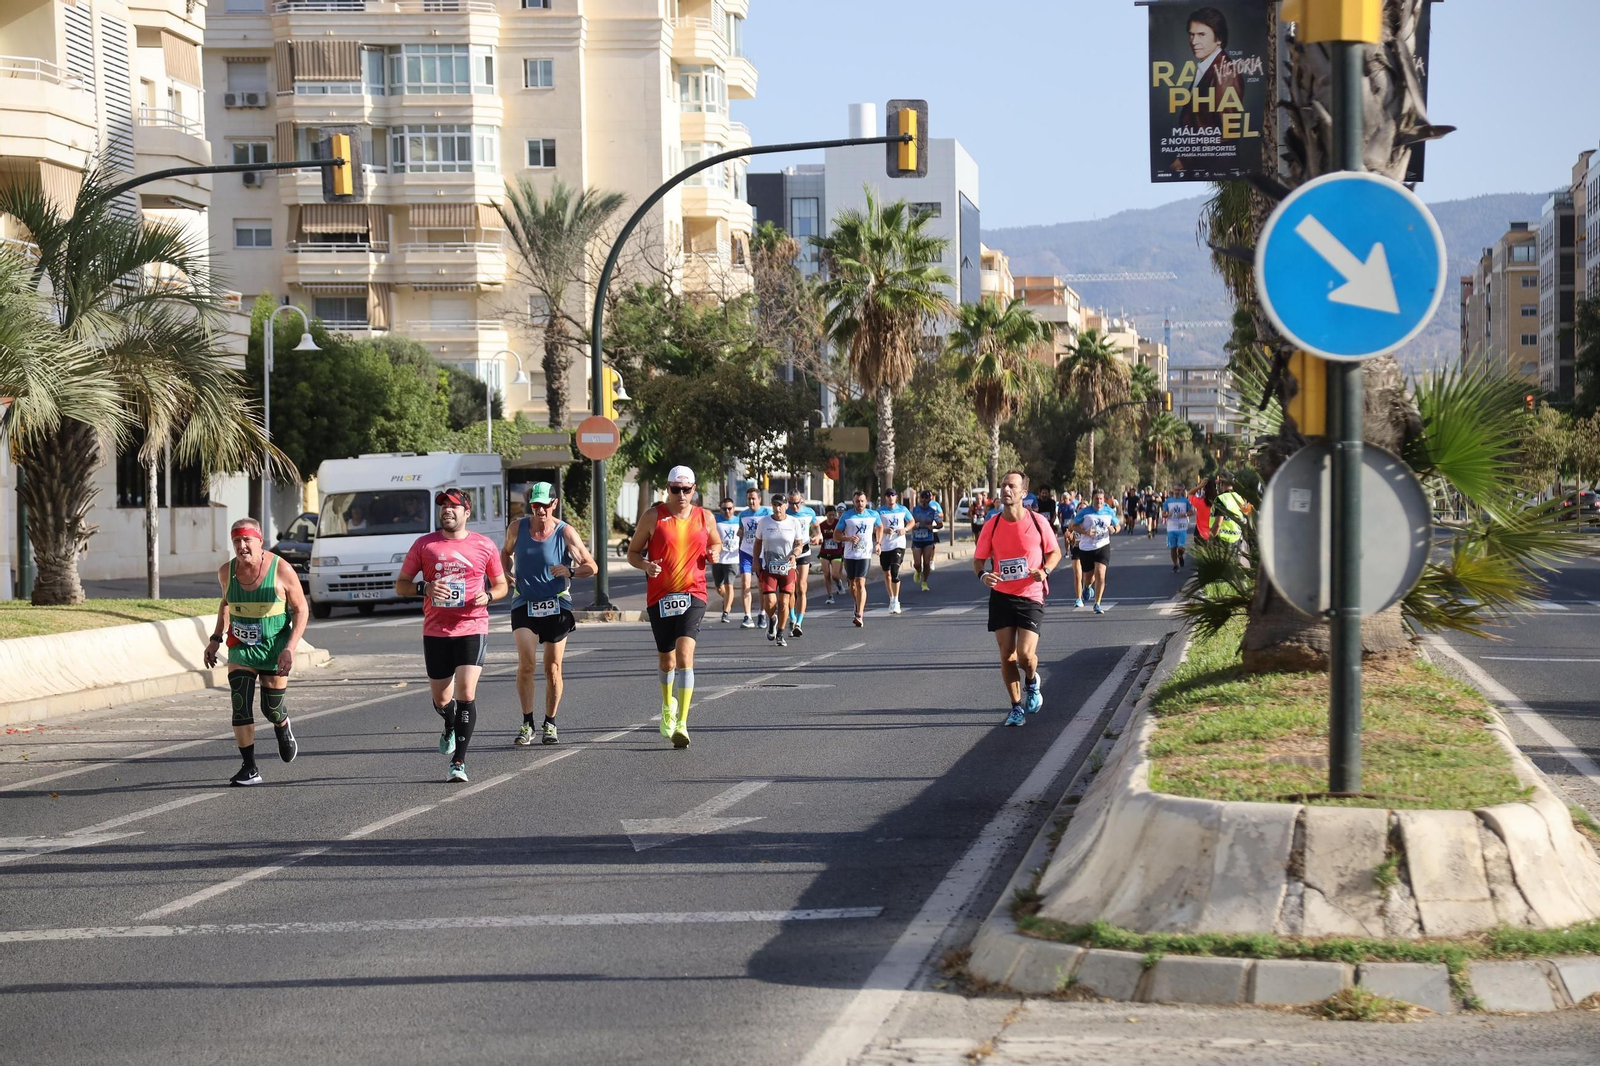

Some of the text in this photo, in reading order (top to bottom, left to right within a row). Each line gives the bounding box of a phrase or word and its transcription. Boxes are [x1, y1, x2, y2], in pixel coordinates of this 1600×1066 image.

[1169, 86, 1244, 114] PHA
[1172, 125, 1222, 137] MÁLAGA
[1222, 112, 1259, 139] EL
[1161, 136, 1221, 146] 2 NOVIEMBRE
[1202, 144, 1237, 152] DEPORTES
[390, 474, 423, 482] PILOTE
[1002, 564, 1023, 575] 661
[532, 600, 555, 611] 543
[664, 600, 687, 610] 300
[234, 627, 257, 640] 335
